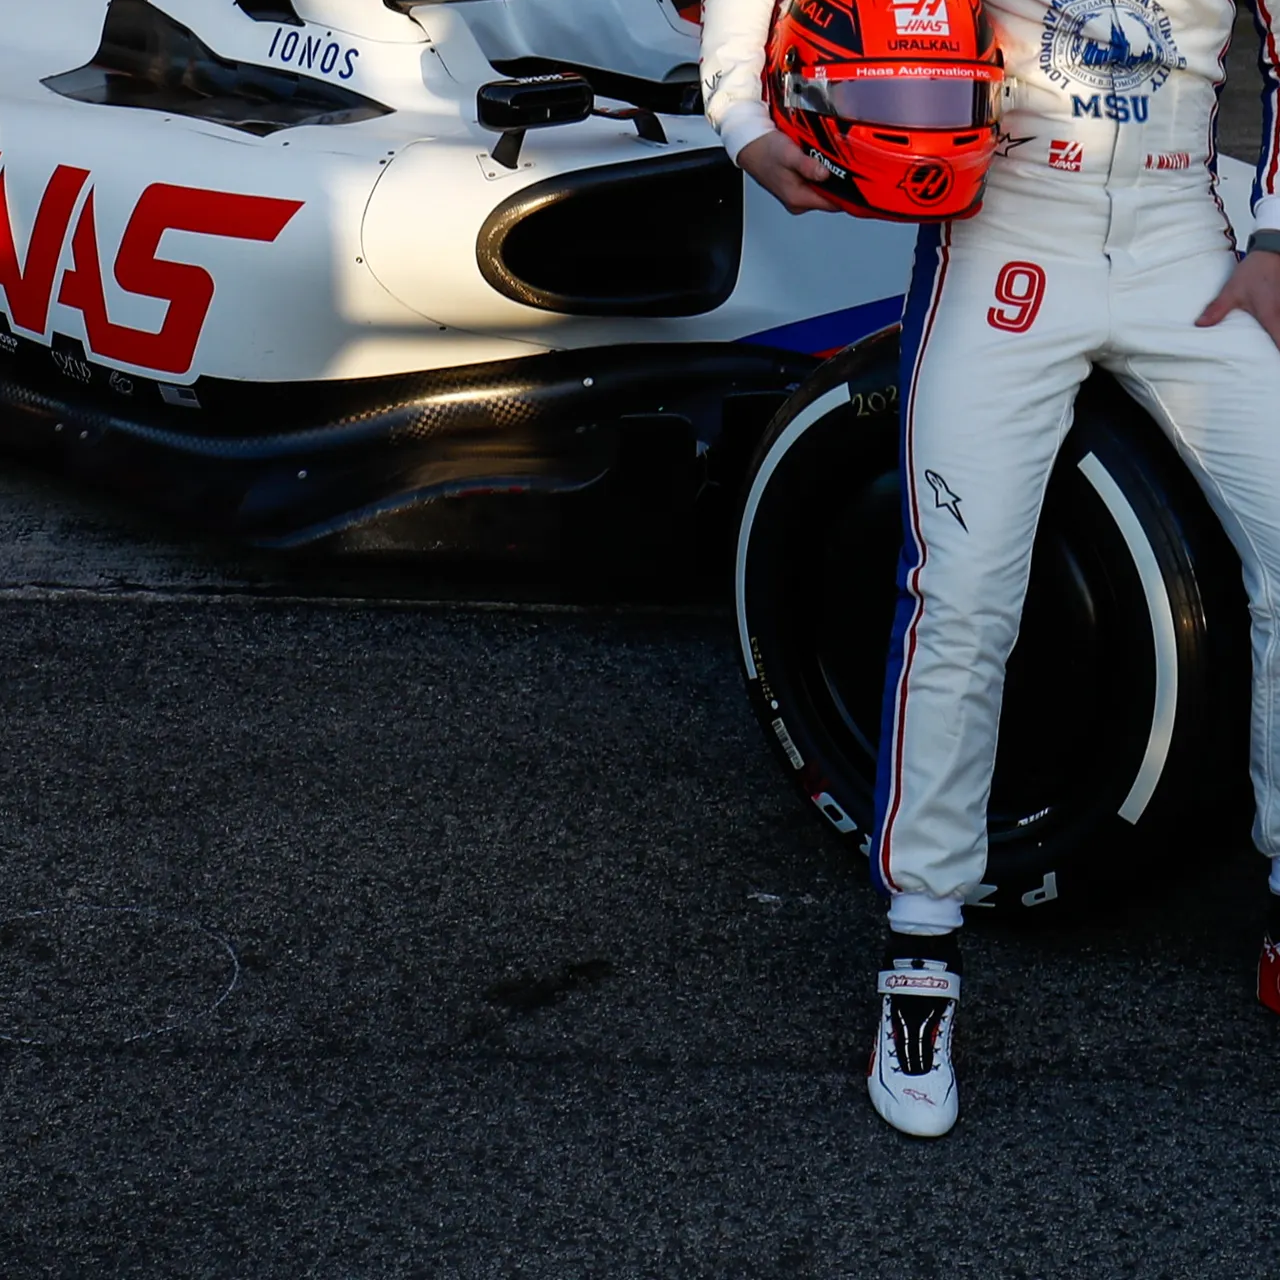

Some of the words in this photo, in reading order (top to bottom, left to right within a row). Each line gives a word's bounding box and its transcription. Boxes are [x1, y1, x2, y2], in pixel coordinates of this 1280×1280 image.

[896, 19, 949, 33] HAAS
[269, 26, 360, 80] IONOS
[887, 39, 960, 53] URALKALI
[856, 66, 894, 77] Haas
[898, 66, 975, 78] Automation
[976, 68, 992, 79] Inc.
[1072, 94, 1150, 123] MSU
[987, 261, 1046, 334] 9
